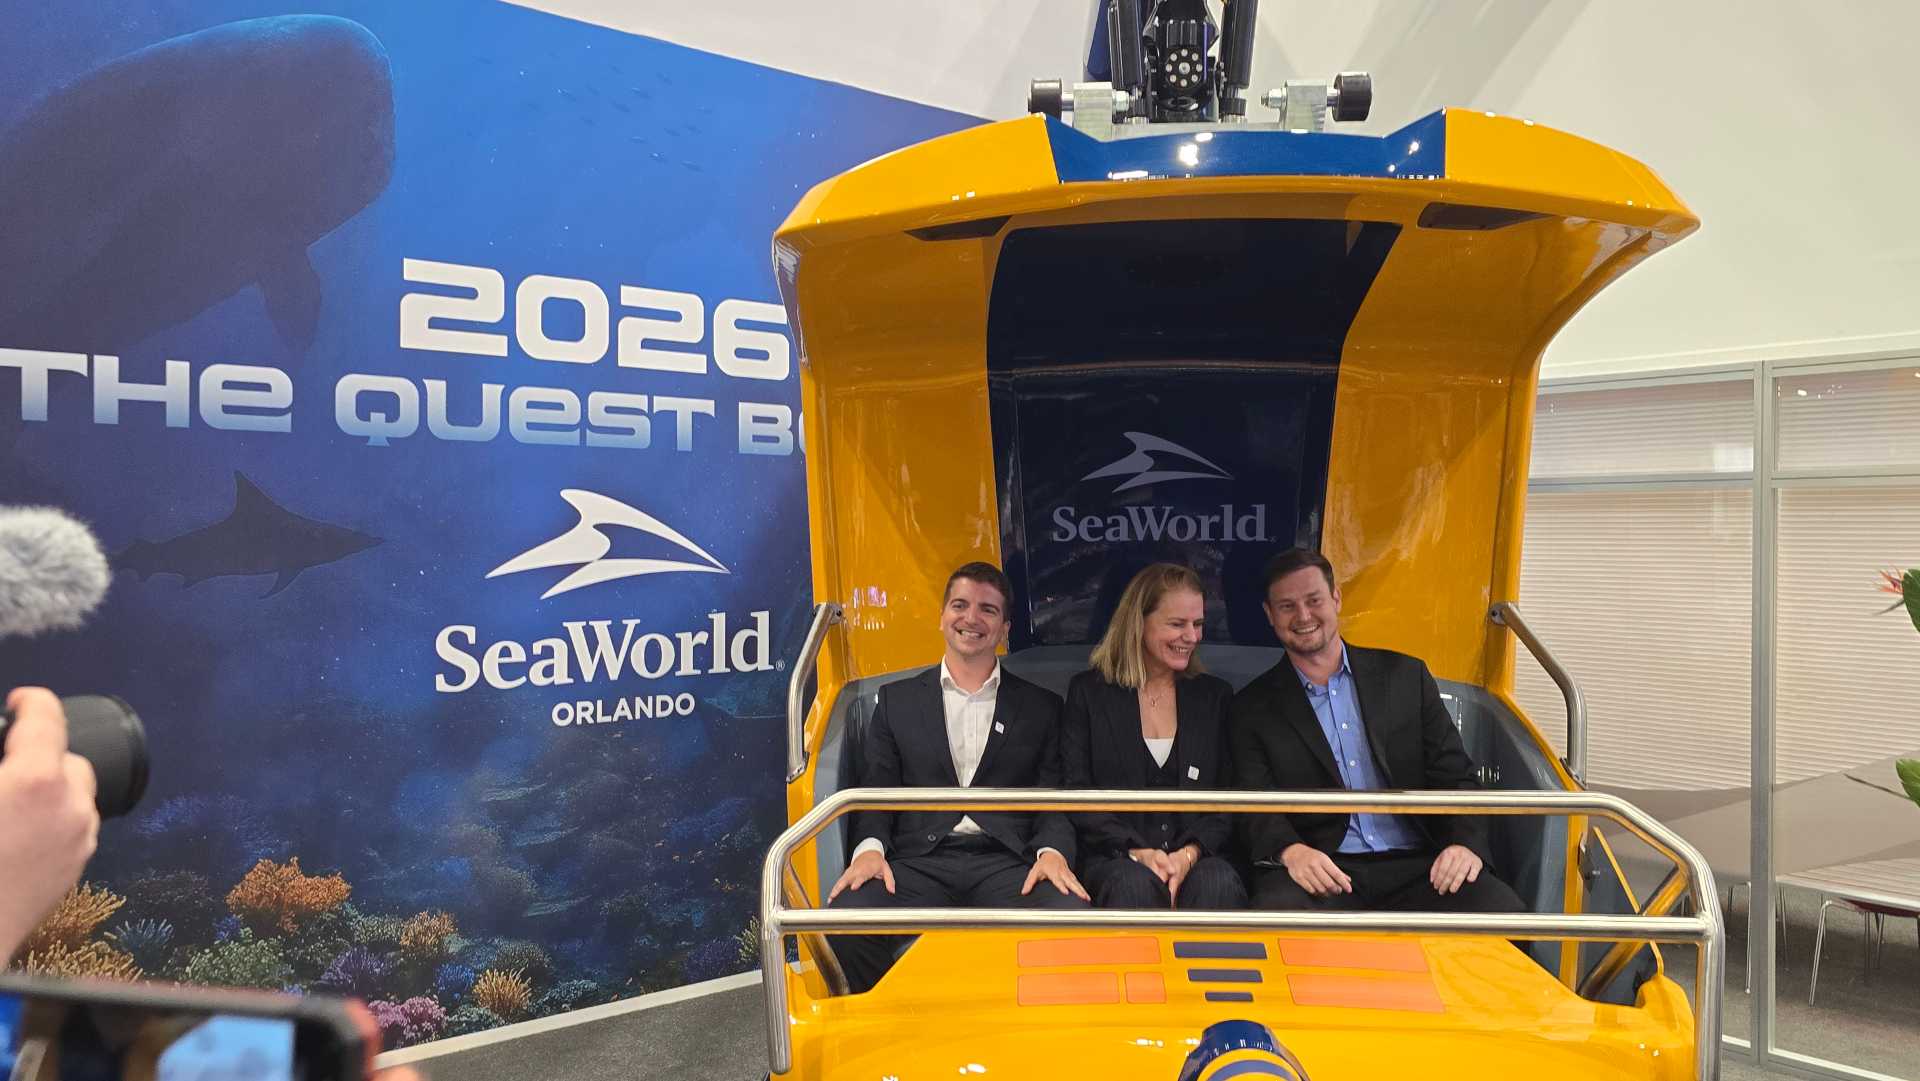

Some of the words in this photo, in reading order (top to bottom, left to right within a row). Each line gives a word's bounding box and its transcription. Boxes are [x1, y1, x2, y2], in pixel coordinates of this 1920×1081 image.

[399, 257, 790, 381] 2026
[738, 401, 806, 456] B
[551, 692, 696, 726] ORLANDO
